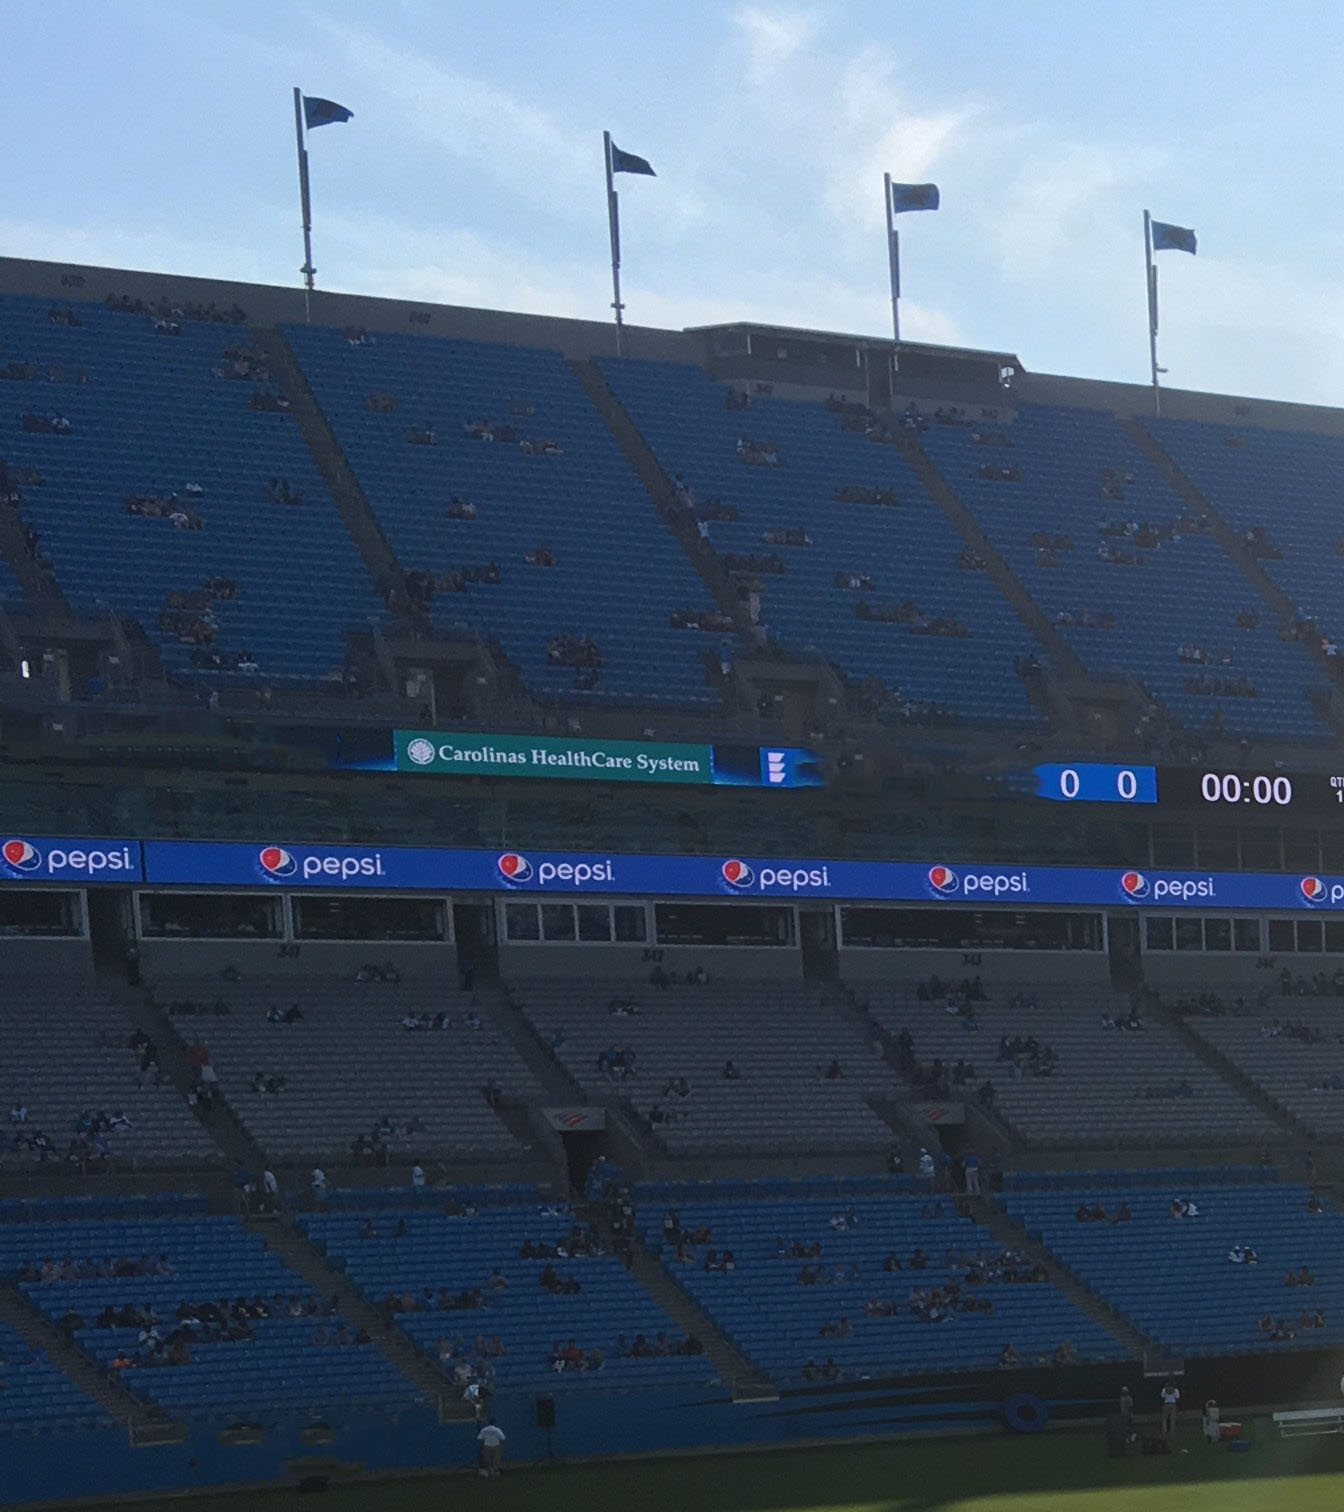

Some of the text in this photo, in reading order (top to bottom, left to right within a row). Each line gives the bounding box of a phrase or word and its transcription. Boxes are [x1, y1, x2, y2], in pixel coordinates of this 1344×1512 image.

[439, 745, 700, 773] Carolinas HealthCare System
[1060, 769, 1080, 798] 0
[1118, 770, 1137, 798] 0
[1201, 773, 1292, 804] 00:00
[1335, 790, 1344, 803] 1
[48, 847, 130, 873] pepsi
[303, 853, 382, 879] pepsi
[539, 859, 612, 885] pepsi
[760, 866, 829, 890] pepsi
[963, 872, 1028, 894] pepsi
[1155, 878, 1214, 900] pepsi
